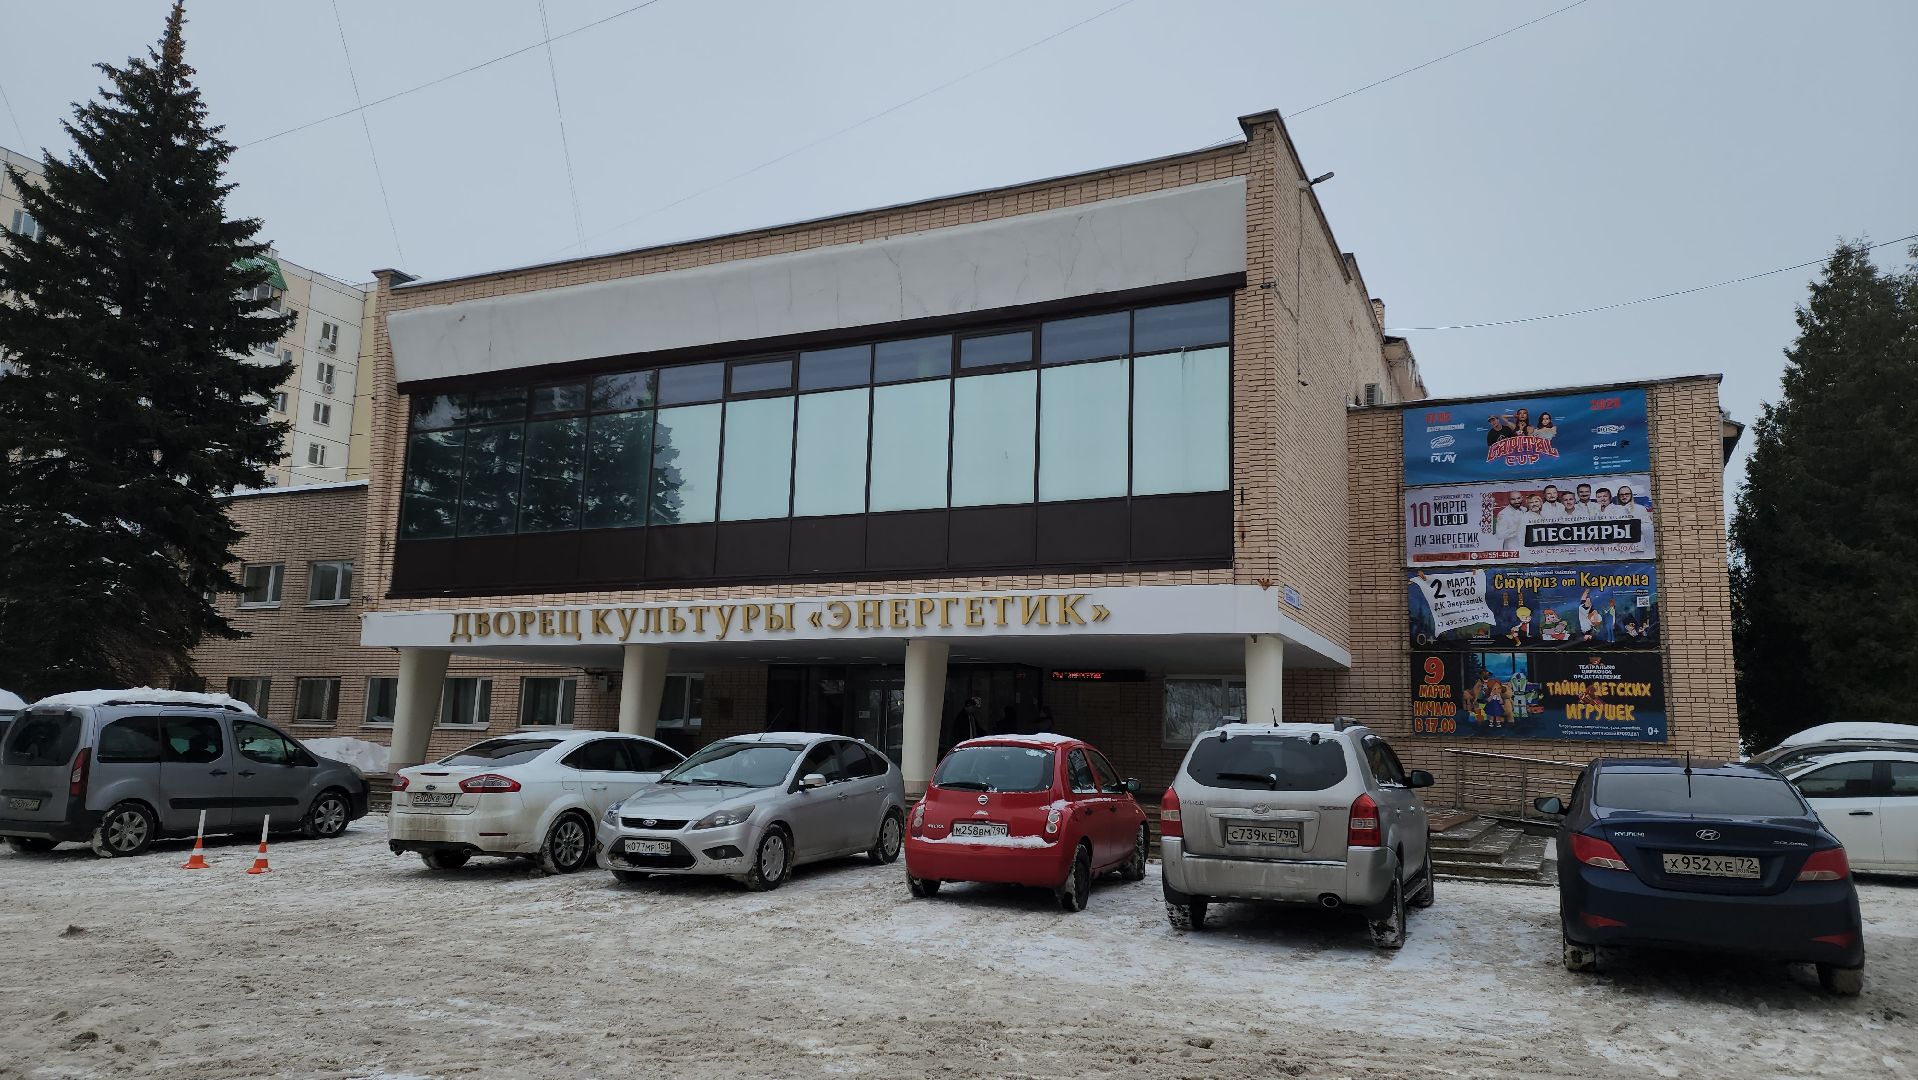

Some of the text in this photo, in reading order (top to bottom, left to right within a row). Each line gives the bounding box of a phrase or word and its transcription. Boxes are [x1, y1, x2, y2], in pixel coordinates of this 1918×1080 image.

[1410, 501, 1431, 527] 10
[1433, 500, 1467, 513] МАРТА
[1437, 514, 1465, 525] 18.00
[1414, 532, 1479, 547] ДК ЭНЕРГЕТИК
[1532, 524, 1632, 543] ПЕСНЯРЫ
[1430, 579, 1446, 599] 2
[1447, 577, 1476, 589] МАРТА
[1494, 571, 1649, 593] Сюрприз от Карлсона
[1452, 588, 1476, 597] 12:00
[1447, 596, 1483, 608] Энергетик
[450, 594, 1111, 643] ДВОРЕЦ КУЛЬТУРЫ «ЭНЕРГЕТИК»
[1417, 633, 1437, 646] 0+
[1424, 656, 1444, 684] 9
[1419, 685, 1451, 698] МАРТА
[1547, 680, 1652, 697] ТАЙНА ДЕТСКИХ
[1414, 700, 1456, 717] НАЧАЛО
[1566, 703, 1635, 721] ИГРУШЕК
[1414, 717, 1456, 733] В 17.00
[1647, 726, 1659, 736] 0+
[1737, 858, 1754, 870] 72
